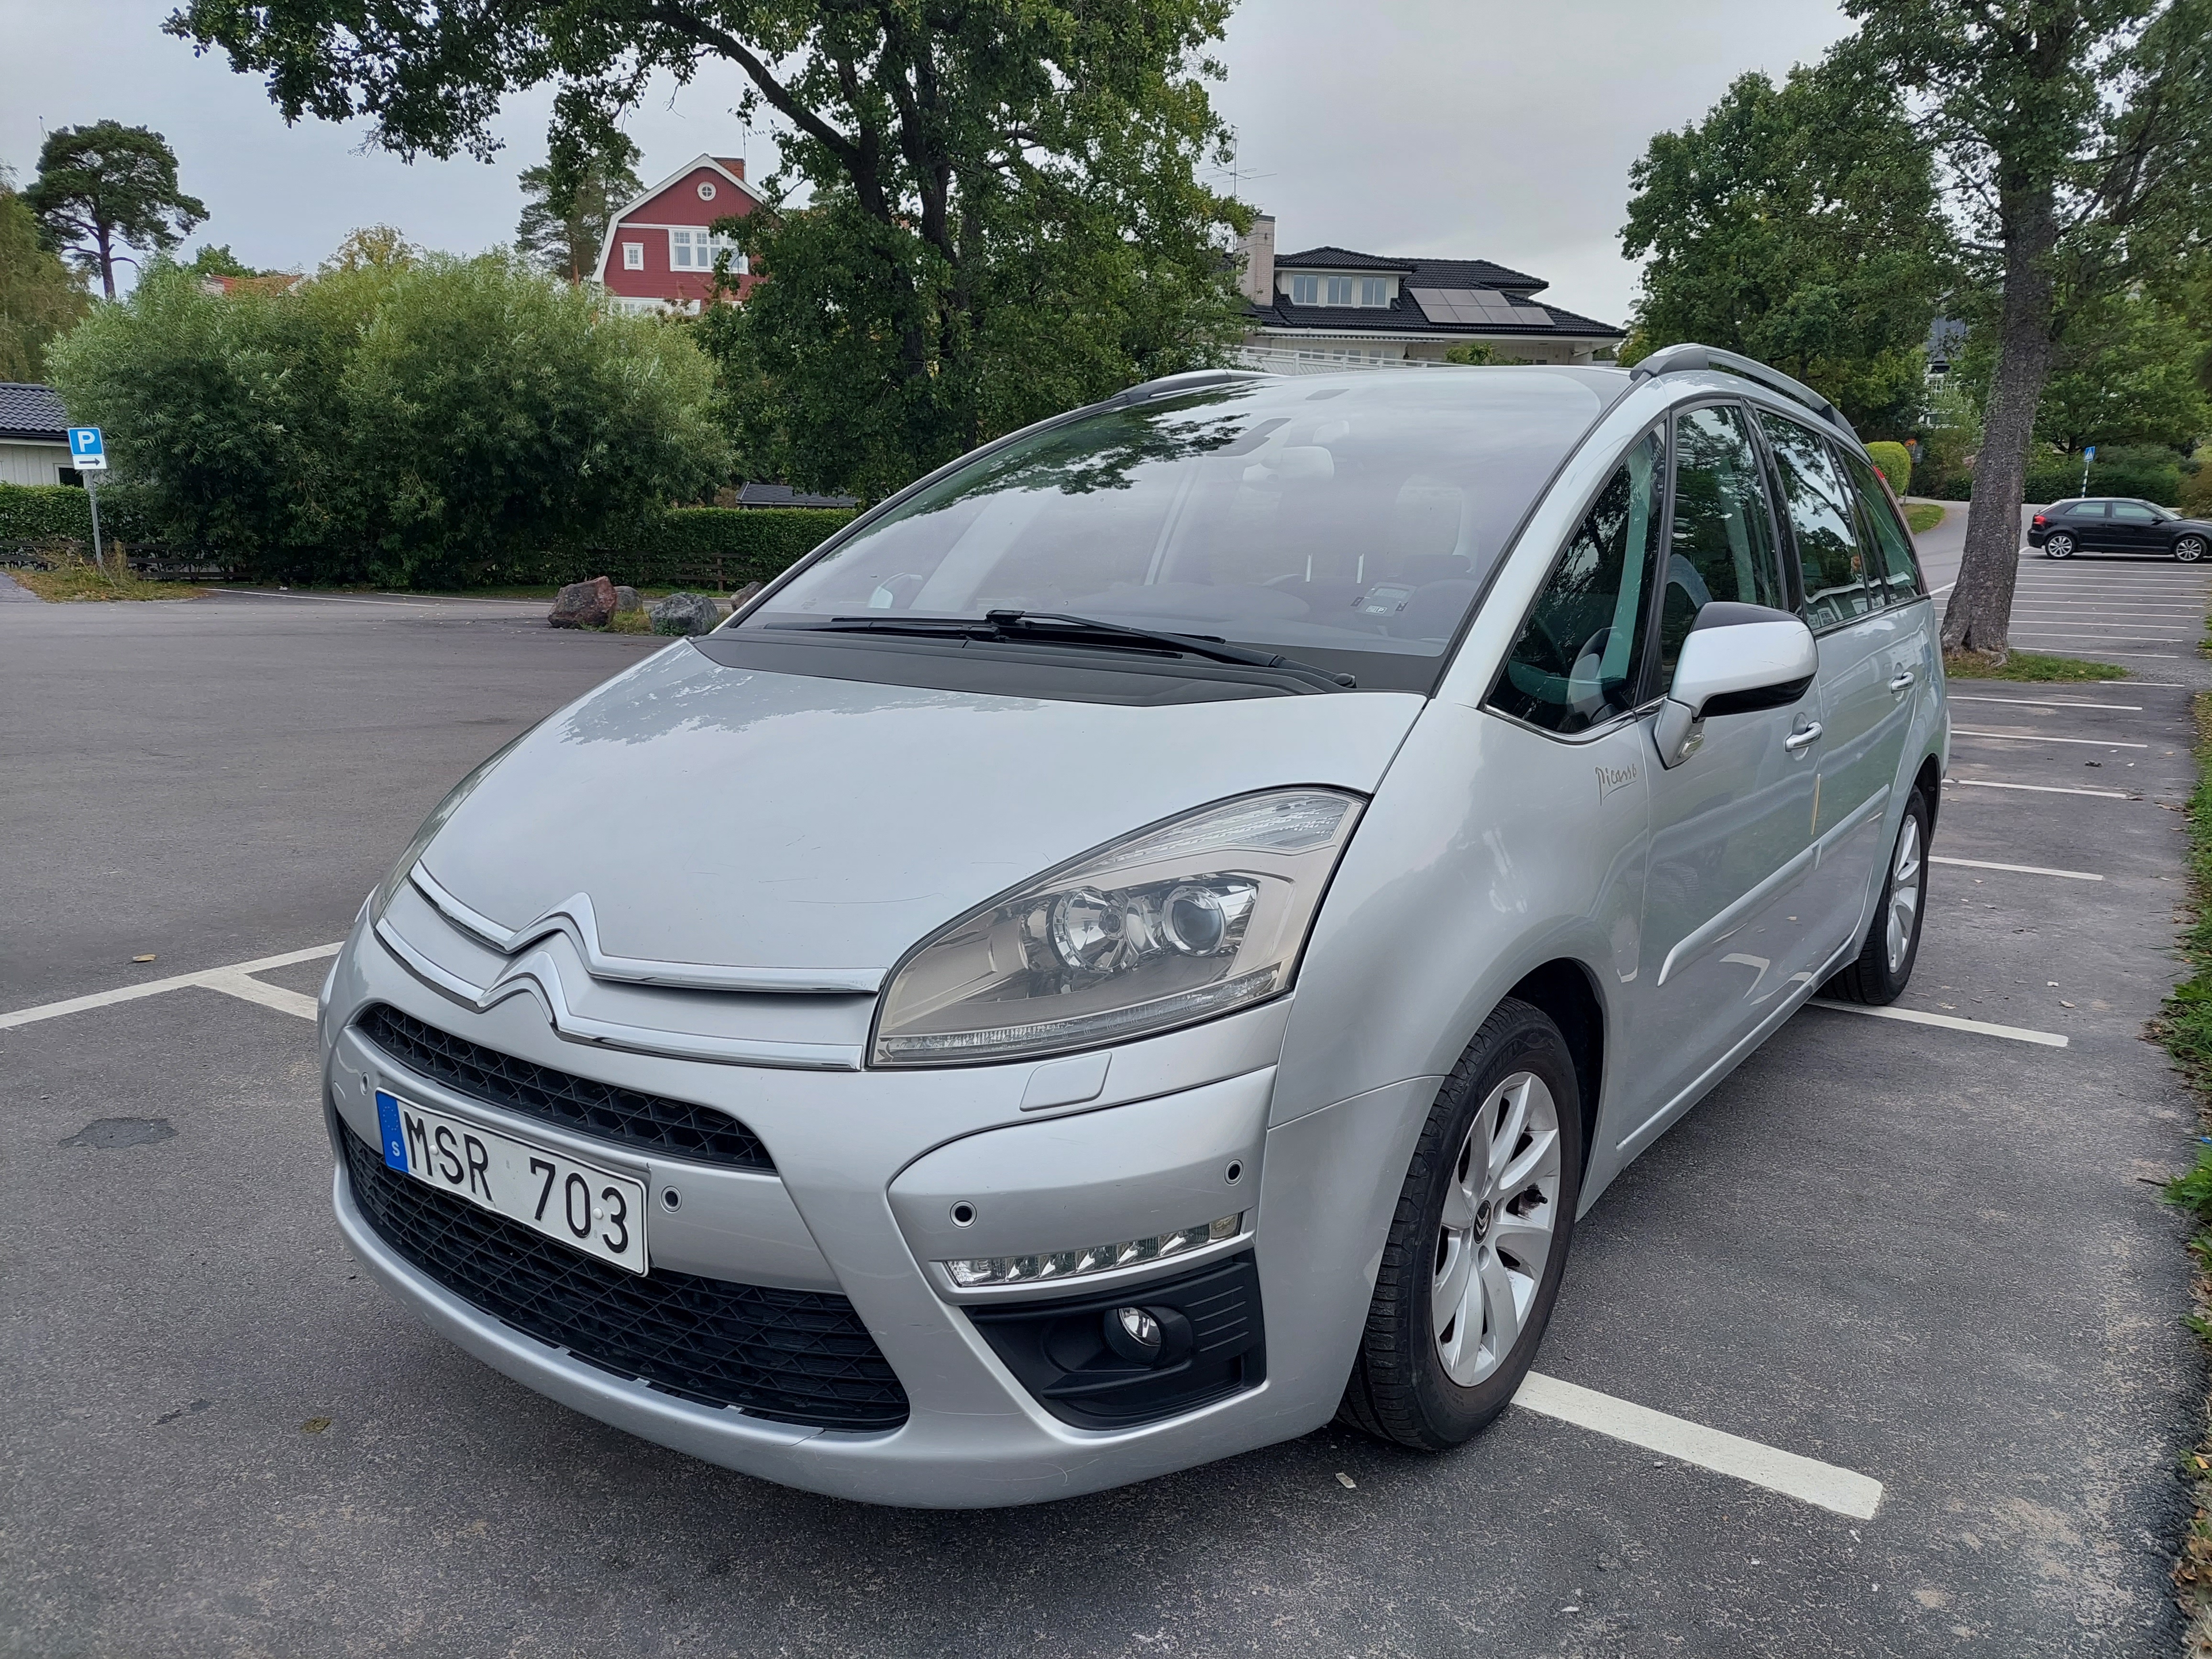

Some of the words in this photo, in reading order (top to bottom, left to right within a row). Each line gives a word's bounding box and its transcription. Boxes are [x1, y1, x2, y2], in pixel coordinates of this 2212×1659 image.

[77, 431, 95, 453] P
[1595, 763, 1637, 806] Picasso
[392, 1141, 400, 1157] S
[403, 1110, 494, 1201] MSR
[530, 1156, 628, 1254] 703
